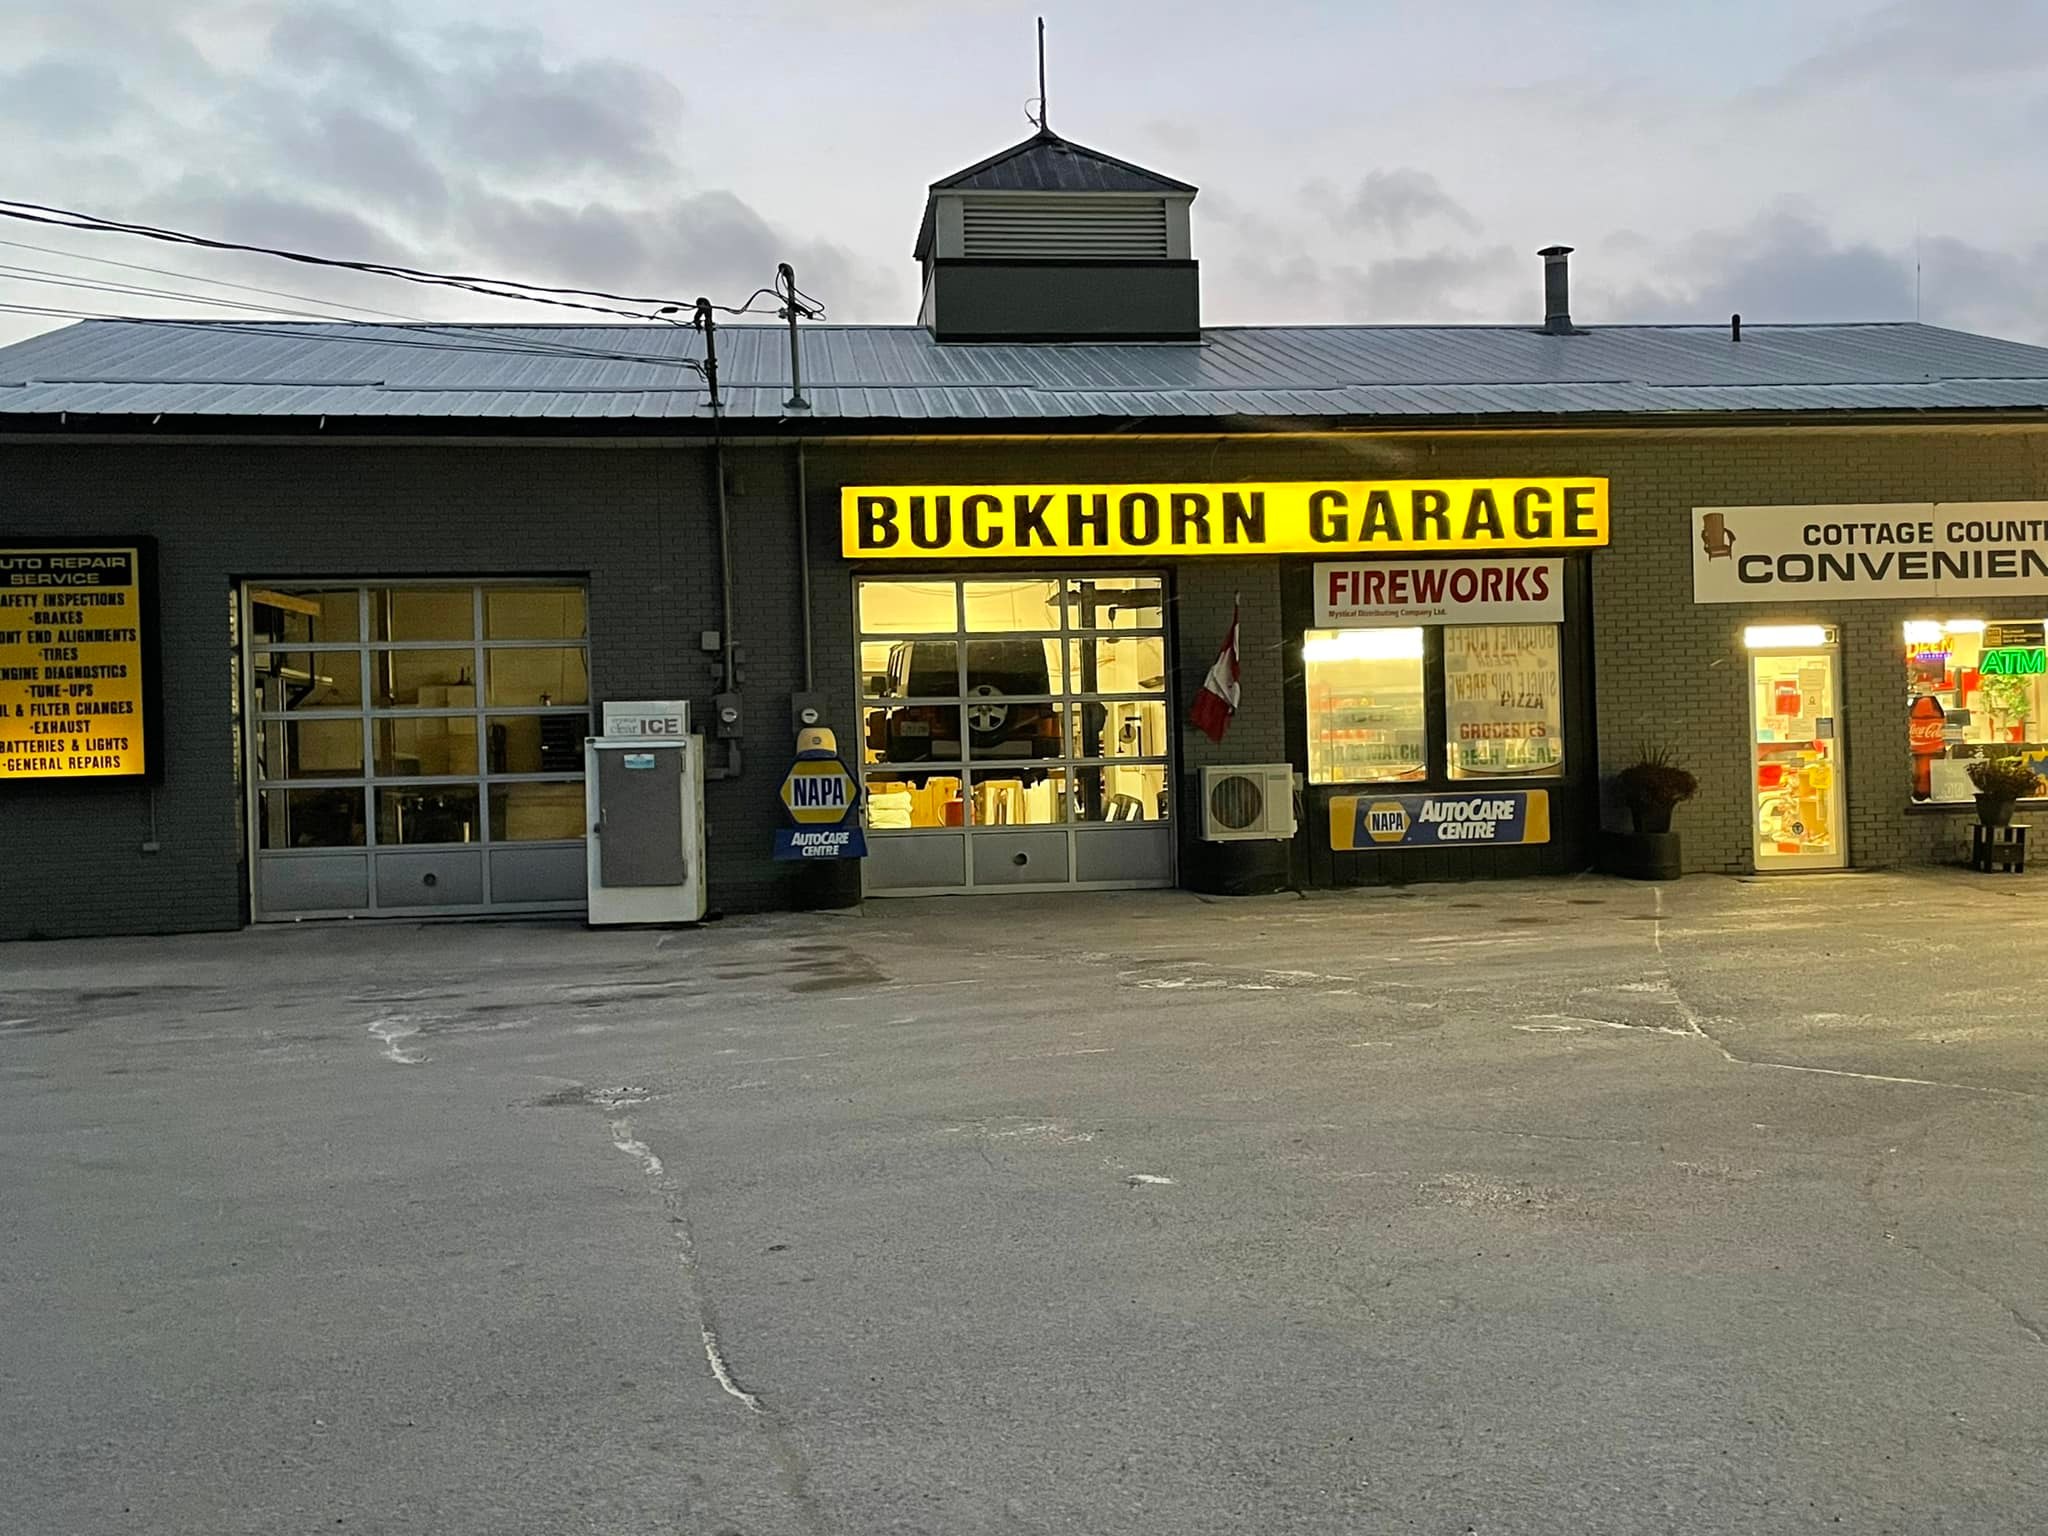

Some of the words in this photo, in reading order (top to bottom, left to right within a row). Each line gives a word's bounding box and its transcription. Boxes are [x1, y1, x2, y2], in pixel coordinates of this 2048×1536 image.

[857, 492, 1265, 549] BUCKHORN
[1308, 487, 1598, 542] GARAGE
[1803, 521, 1933, 546] COTTAGE
[1946, 519, 2048, 544] COUNT
[50, 557, 126, 569] REPAIR
[1738, 549, 2048, 584] CONVENIEN
[10, 573, 100, 585] SERVICE
[1328, 566, 1549, 606] FIREWORKS
[44, 593, 125, 607] INSPECTIONS
[1328, 608, 1357, 619] Mystical
[1358, 607, 1399, 618] Distributing
[1400, 607, 1433, 618] Company
[27, 630, 52, 644] END
[58, 629, 136, 643] ALIGNMENTS
[43, 647, 78, 661] TIRES
[1980, 648, 2046, 675] ATM
[0, 667, 39, 680] NGINE
[45, 665, 127, 679] DIAGNOSTICS
[1500, 691, 1545, 709] PIZZA
[15, 704, 24, 717] &
[30, 702, 70, 717] FILTER
[76, 701, 133, 715] CHANGES
[34, 720, 91, 734] EXHAUST
[640, 718, 678, 734] ICE
[1460, 721, 1546, 740] GROCERIES
[0, 739, 65, 753] BATTERIES
[72, 739, 79, 752] &
[86, 737, 128, 751] LIGHTS
[8, 757, 63, 771] GENERAL
[68, 755, 121, 769] REPAIRS
[794, 777, 844, 806] NAPA
[1371, 811, 1404, 832] NAPA
[1437, 821, 1496, 840] CENTRE
[802, 845, 839, 857] CENTRE
